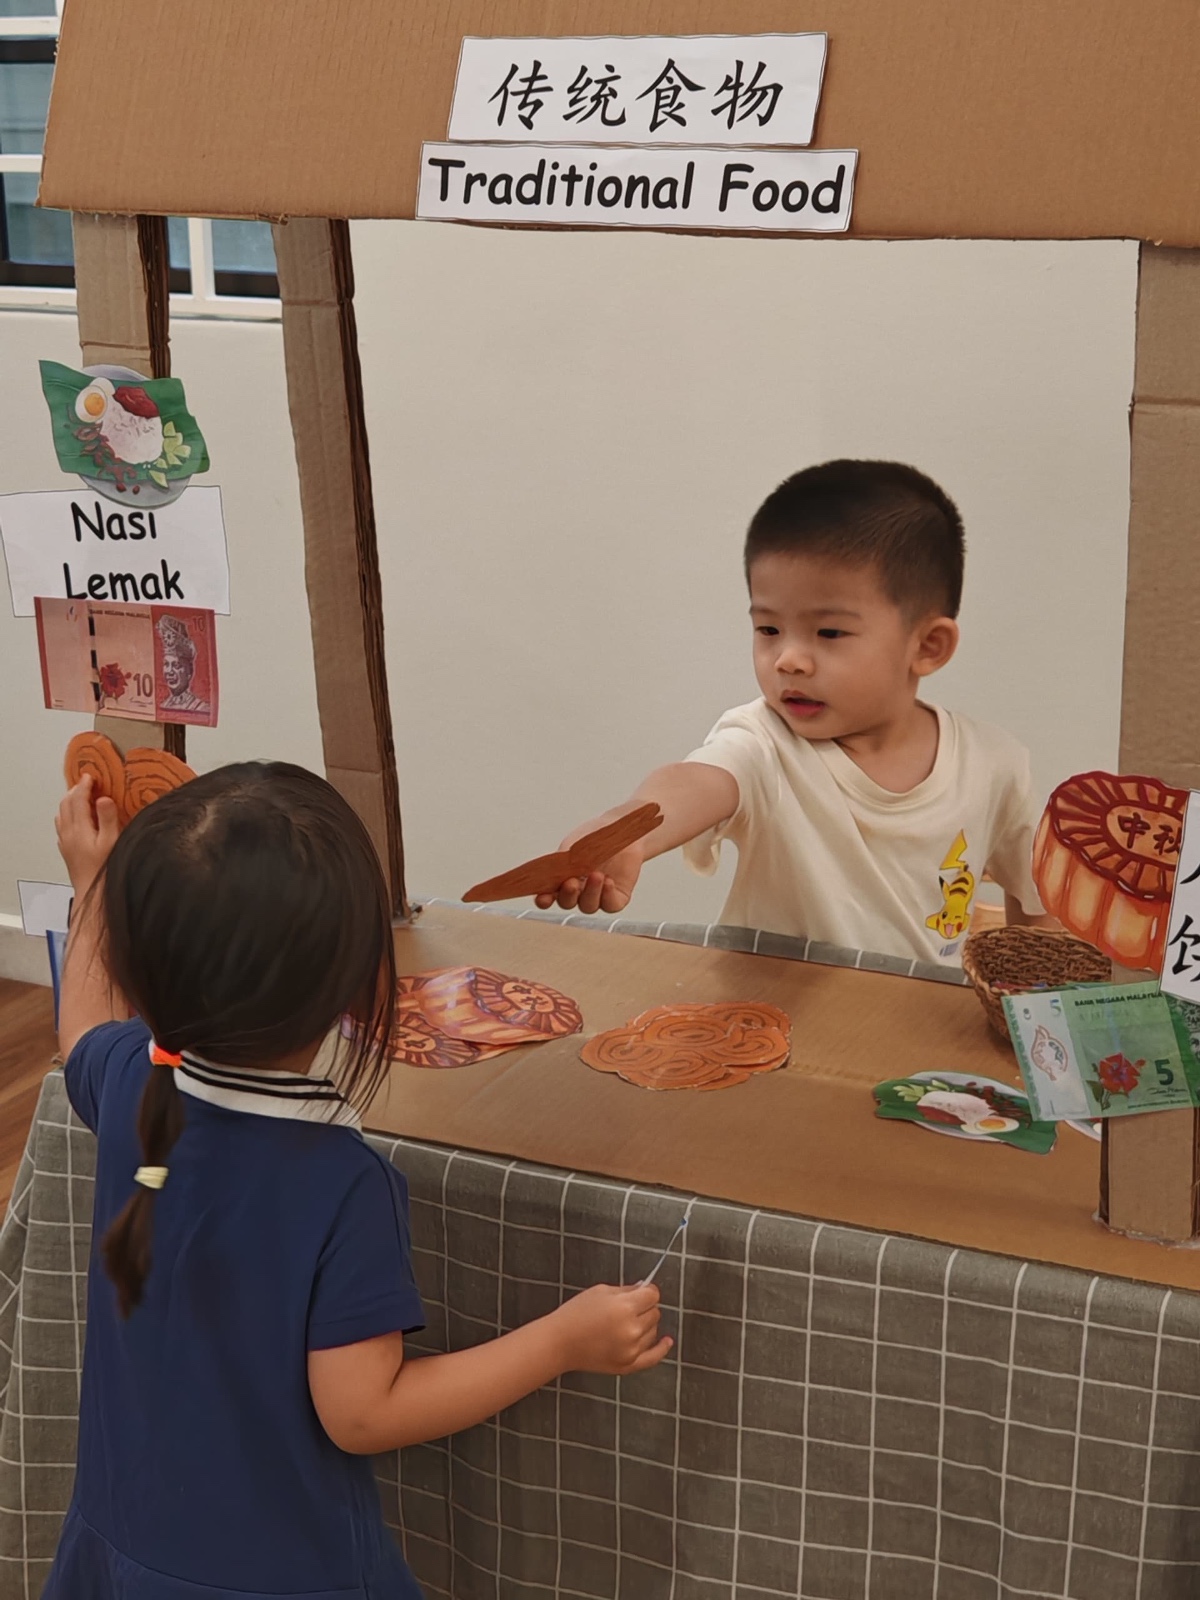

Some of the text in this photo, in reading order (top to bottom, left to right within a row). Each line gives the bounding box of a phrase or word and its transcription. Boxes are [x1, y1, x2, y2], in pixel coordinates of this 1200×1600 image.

[487, 58, 784, 132] 传统食物
[428, 158, 846, 214] Traditional Food
[71, 501, 157, 542] Nasi
[63, 559, 185, 602] Lemak
[133, 673, 153, 697] 10
[1154, 1058, 1174, 1086] 5
